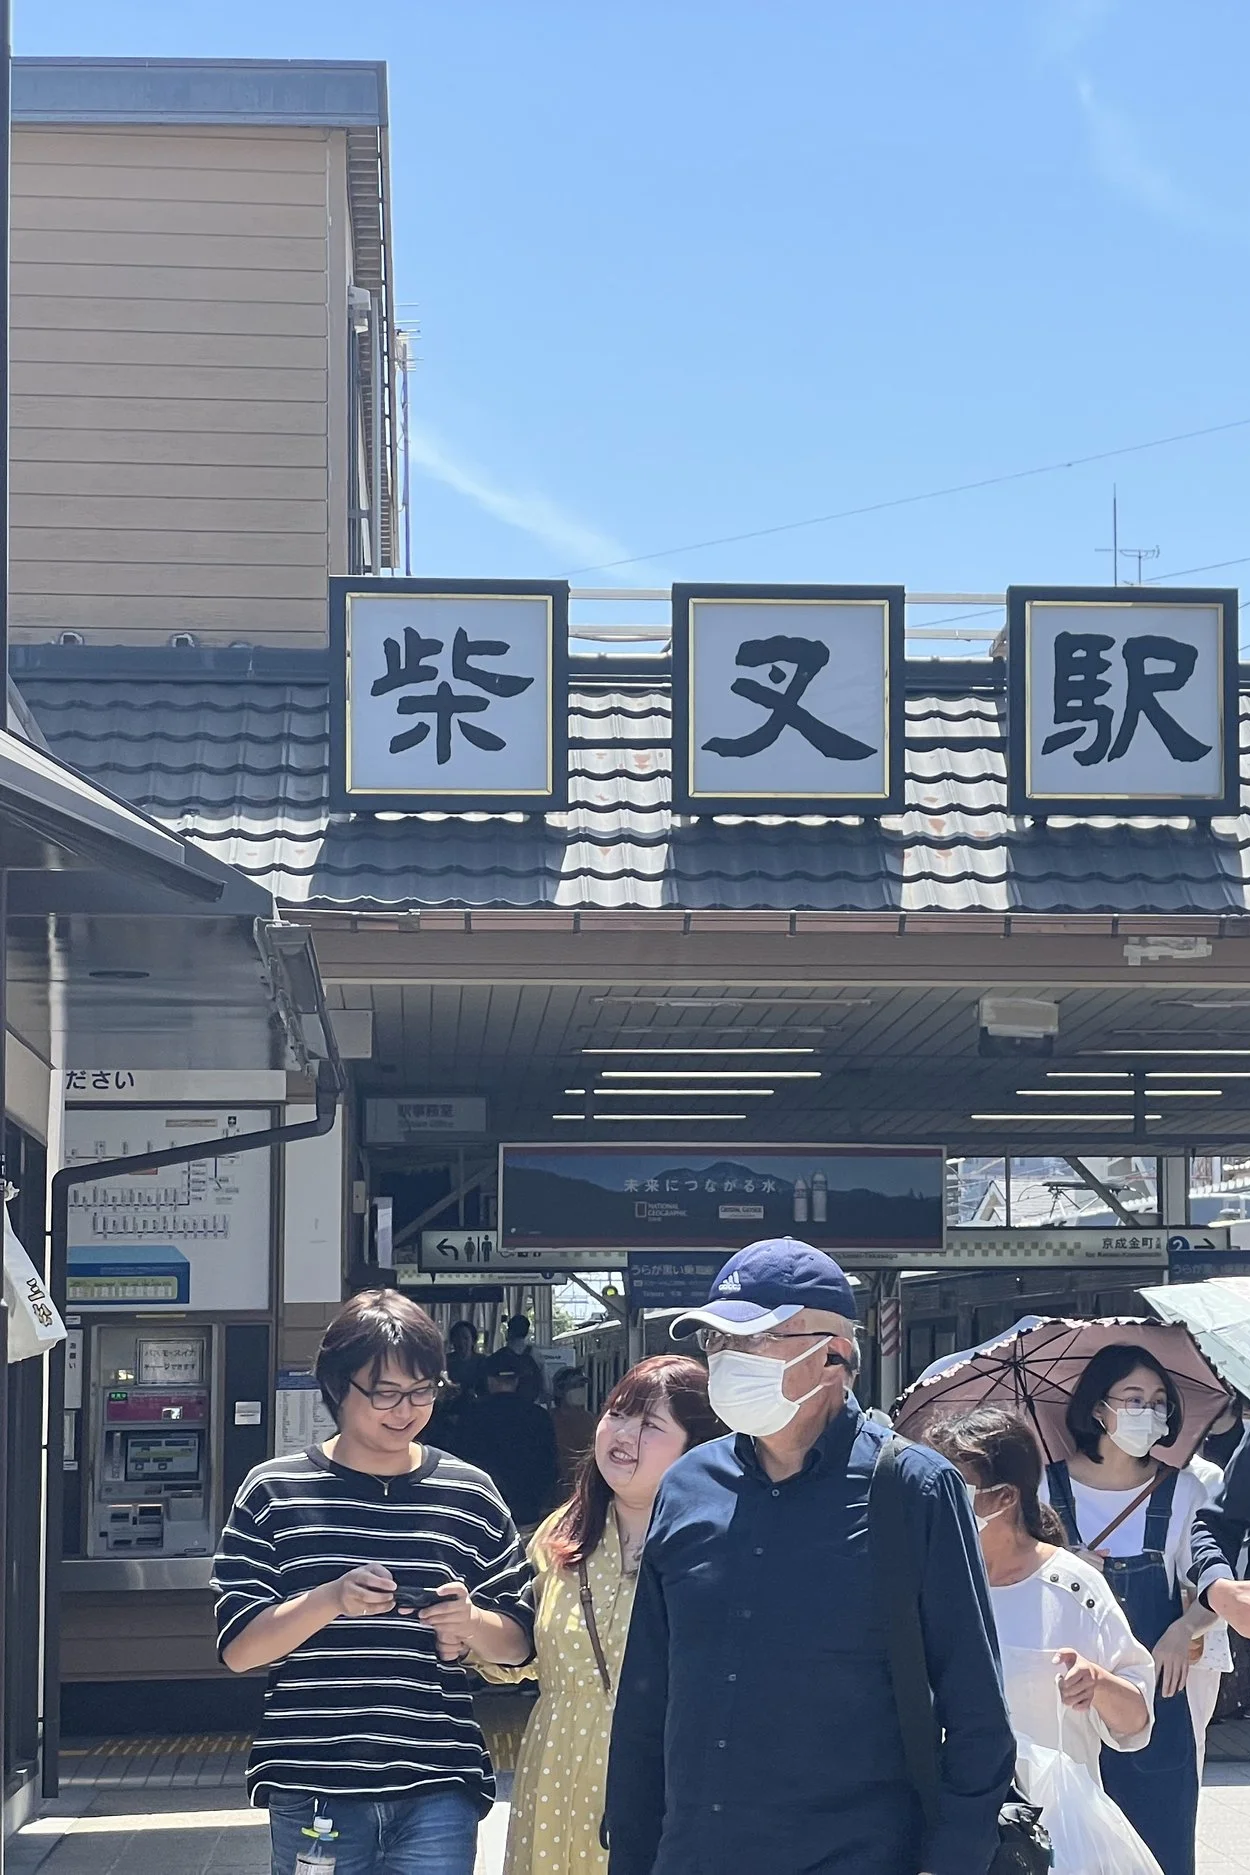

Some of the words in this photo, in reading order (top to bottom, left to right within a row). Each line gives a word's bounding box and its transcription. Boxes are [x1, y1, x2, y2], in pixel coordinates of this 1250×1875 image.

[370, 626, 1213, 766] 柴又駅
[66, 1071, 134, 1089] ださい
[624, 1178, 776, 1193] 未来につながる水
[1102, 1237, 1153, 1249] 京成金町
